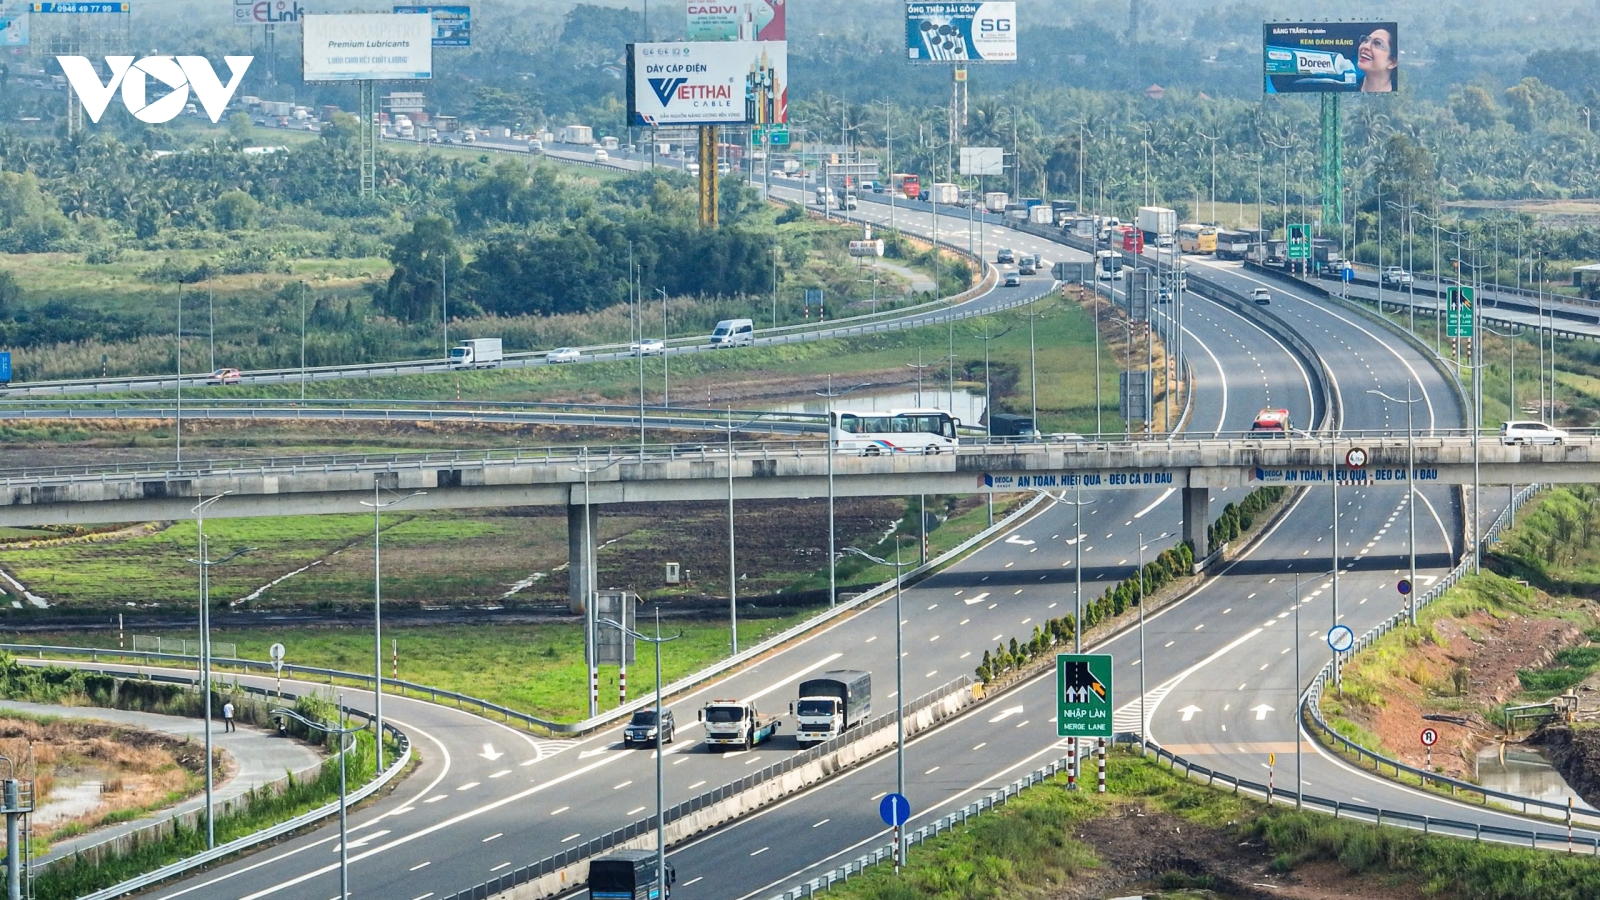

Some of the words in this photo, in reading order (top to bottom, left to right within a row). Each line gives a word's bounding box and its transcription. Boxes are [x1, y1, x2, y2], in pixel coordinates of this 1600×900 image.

[688, 5, 737, 15] CADIVI
[908, 4, 924, 13] ỐNG
[926, 4, 945, 13] THÉP
[981, 19, 1011, 32] SG
[328, 40, 365, 48] Premium
[366, 39, 410, 48] Lubricants
[1299, 56, 1331, 68] Doreen
[646, 64, 664, 73] DÂY
[666, 63, 684, 73] CÁP
[686, 62, 707, 74] ĐIỆN
[994, 476, 1013, 484] DEOCA
[1017, 476, 1031, 487] AN
[1033, 472, 1059, 488] TOÀN,
[1109, 471, 1127, 485] ĐÈO
[1143, 472, 1152, 484] ĐI
[1285, 469, 1297, 481] AN
[1064, 708, 1087, 719] NHẬP
[1089, 708, 1106, 718] LÀN
